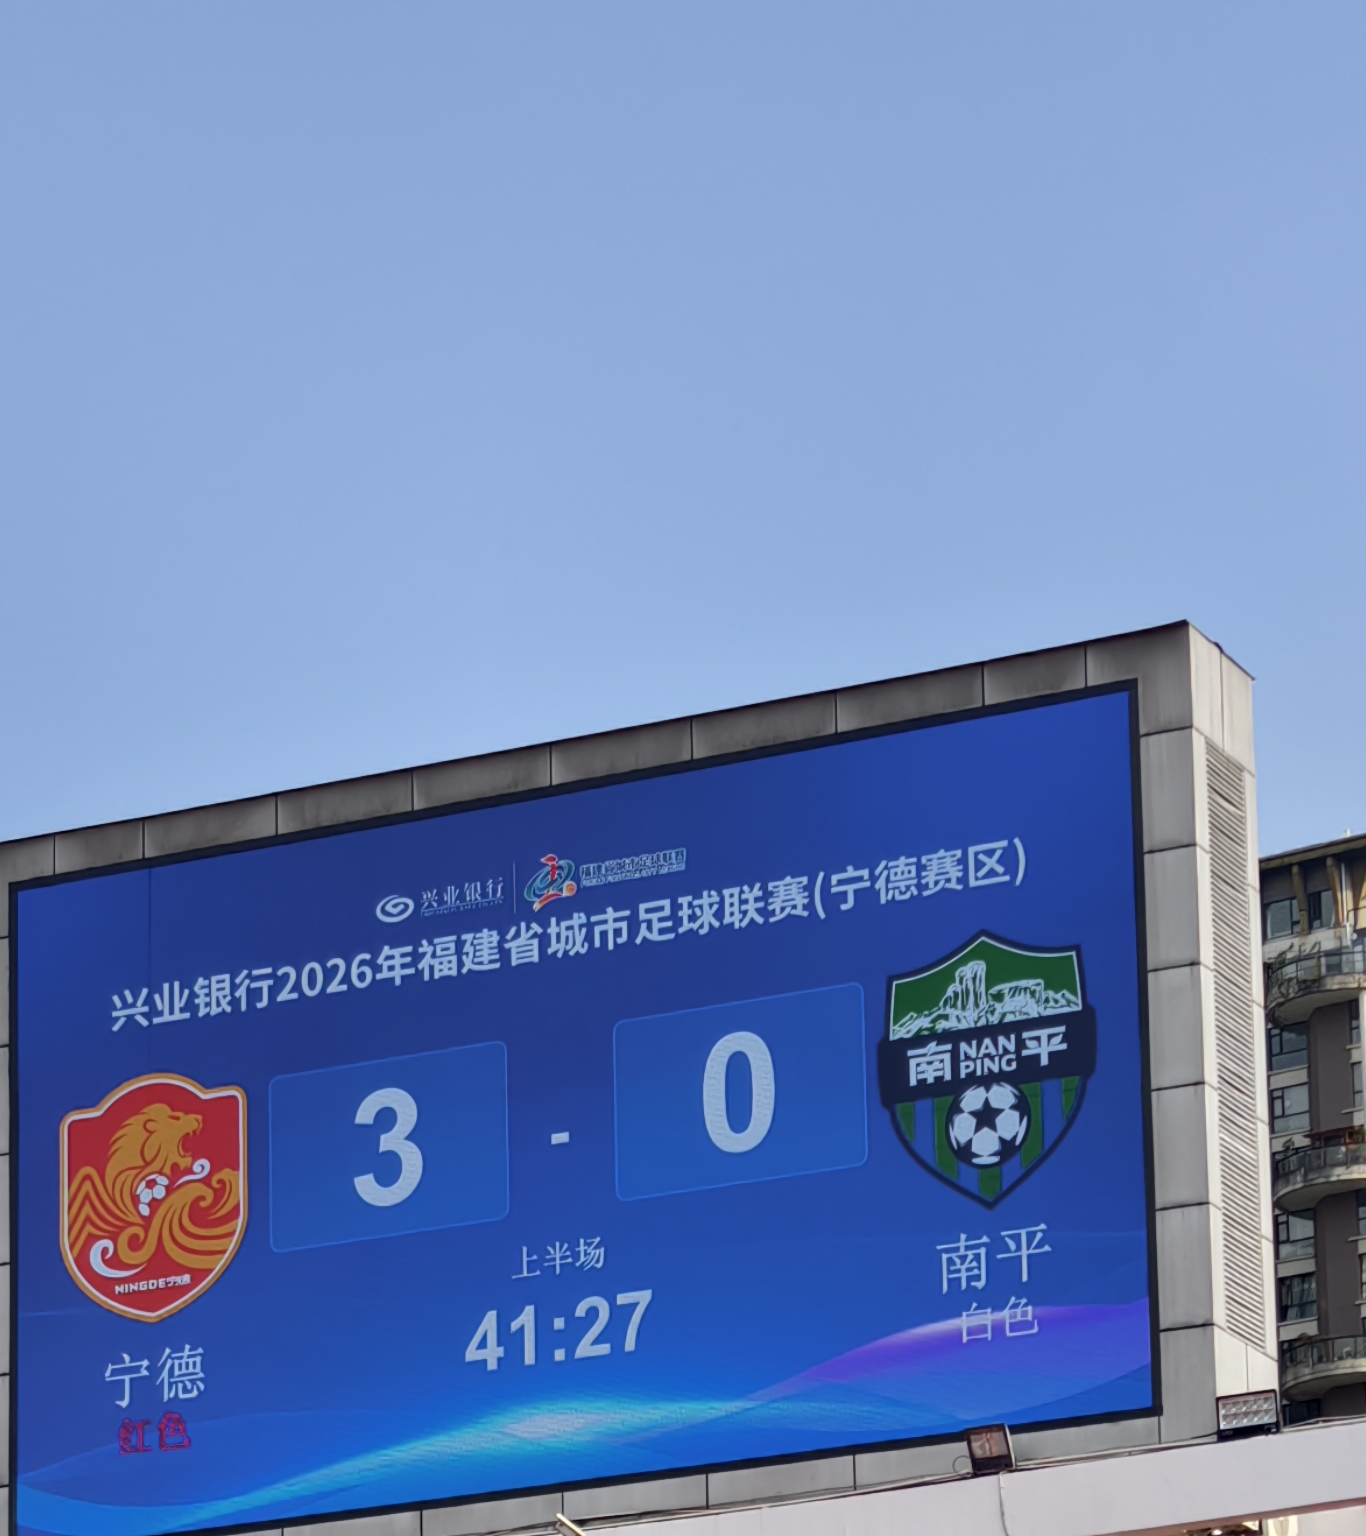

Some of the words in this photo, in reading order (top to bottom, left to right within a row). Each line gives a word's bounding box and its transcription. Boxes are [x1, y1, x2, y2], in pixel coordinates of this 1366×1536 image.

[421, 876, 503, 907] 兴业银行
[111, 837, 1026, 1031] 兴业银行2026年福建省城市足球联赛(宁德赛区)
[907, 1040, 952, 1087] 南
[960, 1033, 1016, 1061] NAN
[960, 1054, 1017, 1079] PING
[1021, 1025, 1067, 1066] 平
[353, 1087, 424, 1207] 3
[702, 1031, 775, 1153] 0
[511, 1236, 605, 1280] 上半场
[936, 1223, 1052, 1294] 南平
[465, 1289, 653, 1371] 41:27
[961, 1296, 1039, 1344] 白色
[105, 1344, 205, 1408] 宁德
[119, 1411, 191, 1455] 红色
